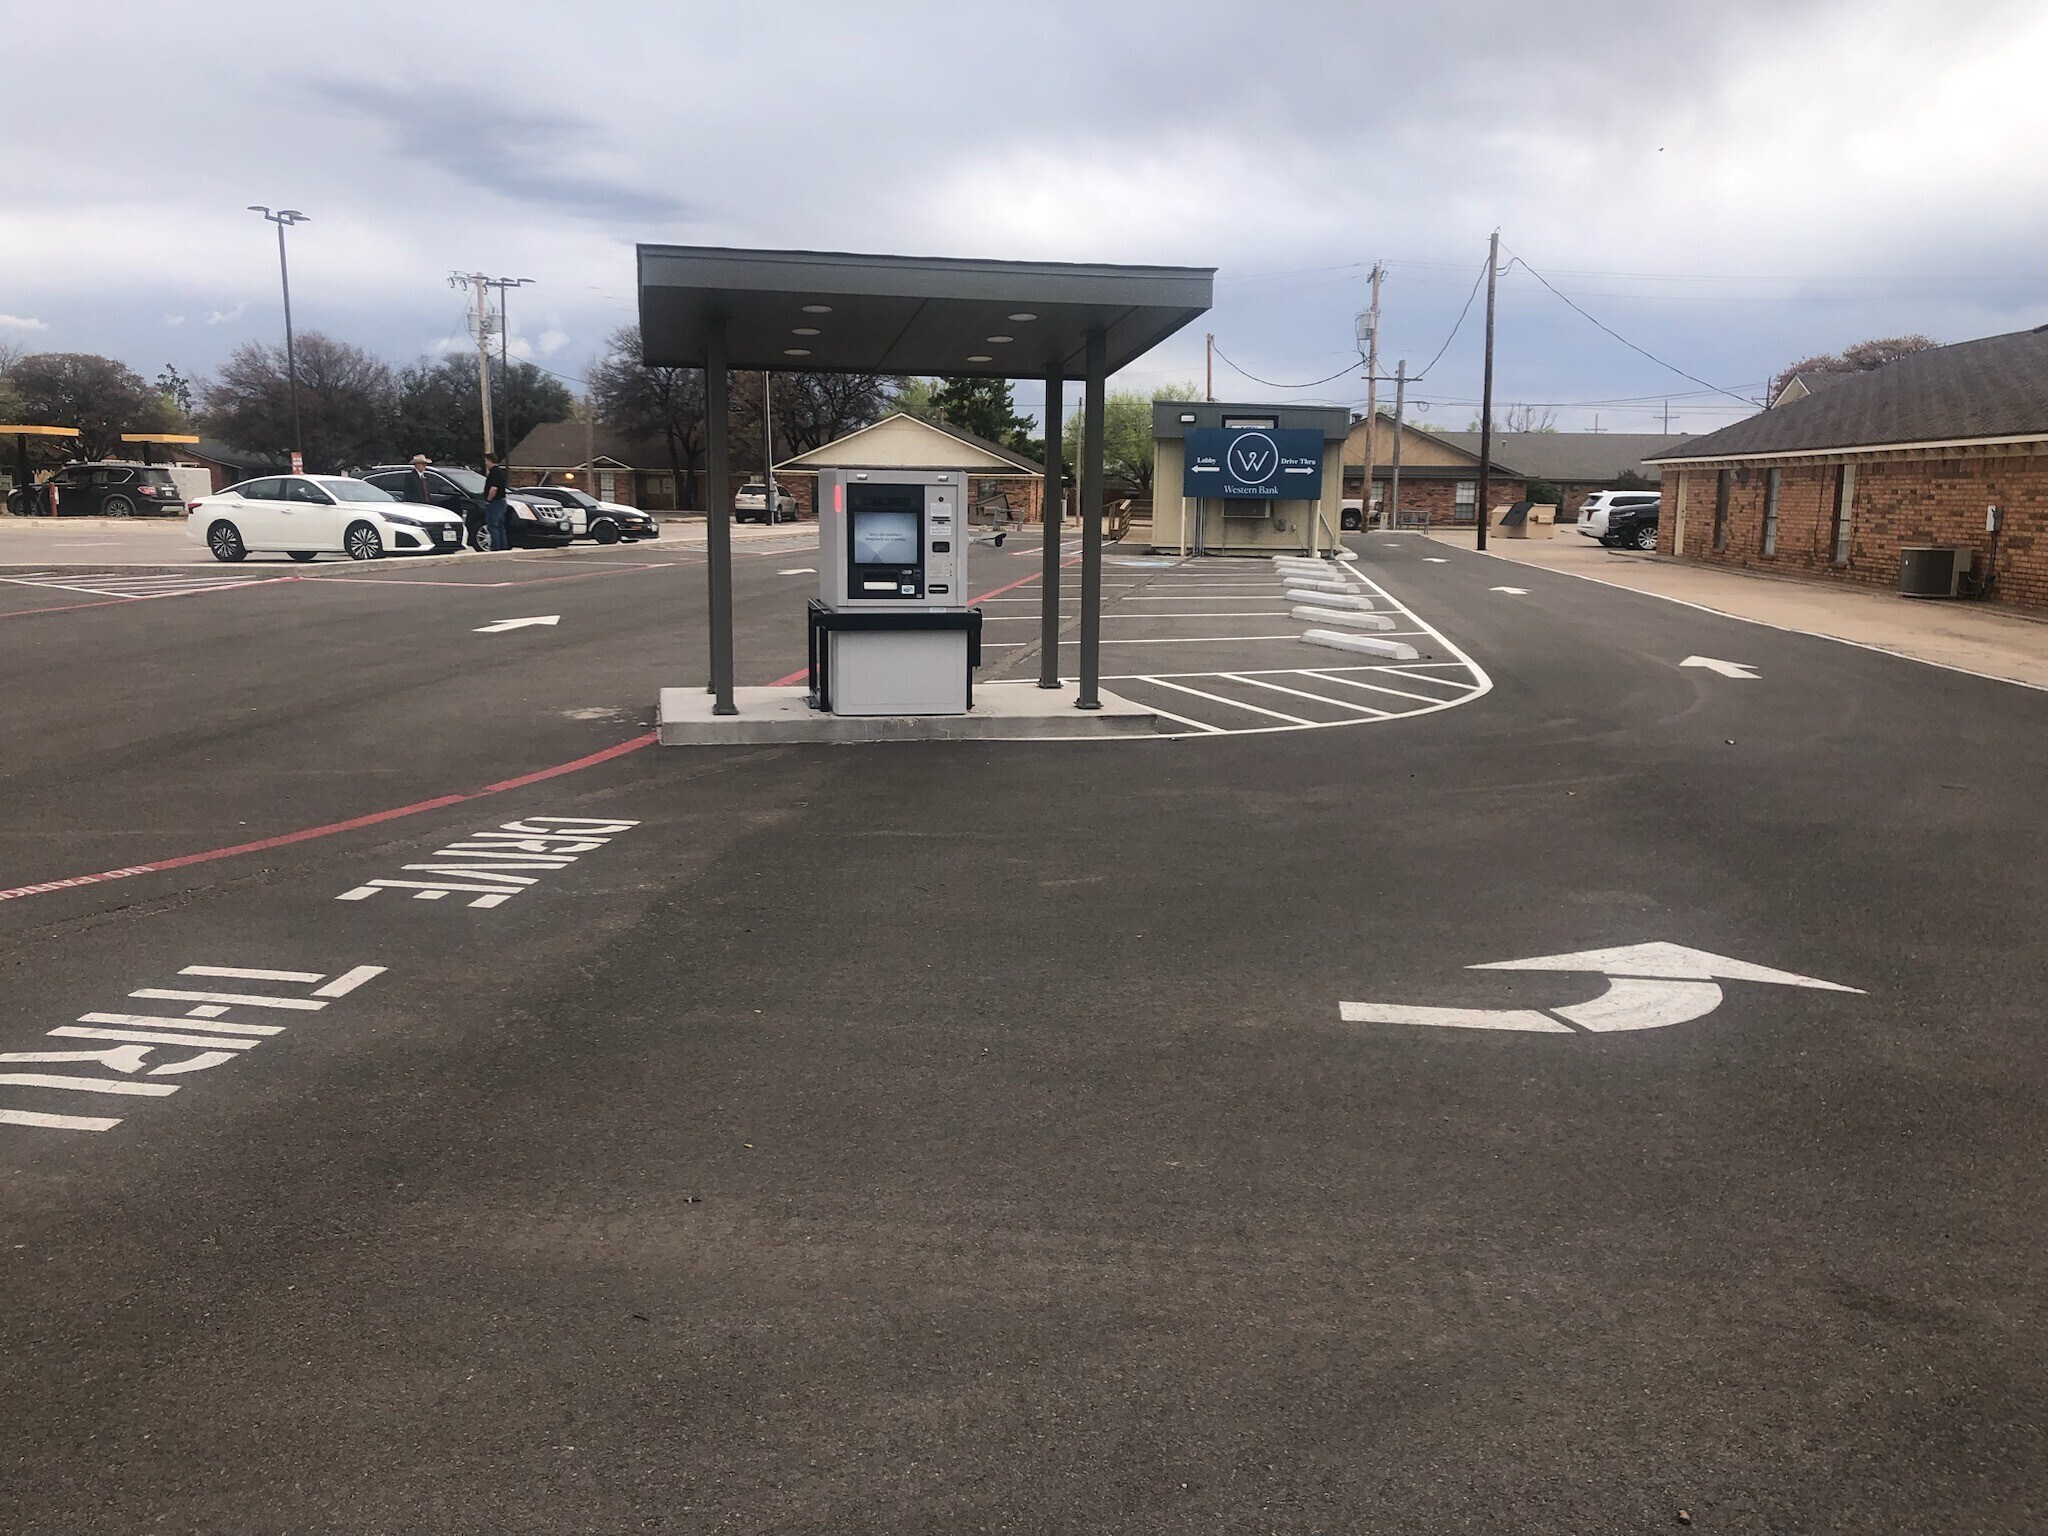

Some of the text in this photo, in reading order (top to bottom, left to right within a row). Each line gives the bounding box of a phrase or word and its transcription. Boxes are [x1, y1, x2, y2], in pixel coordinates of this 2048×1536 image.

[1197, 456, 1217, 465] Lobby
[1281, 458, 1316, 466] Drive Thru
[1224, 485, 1279, 495] Western Bank
[334, 816, 642, 909] DRIVE
[0, 865, 156, 901] NO PARKI
[0, 965, 389, 1131] THRU
